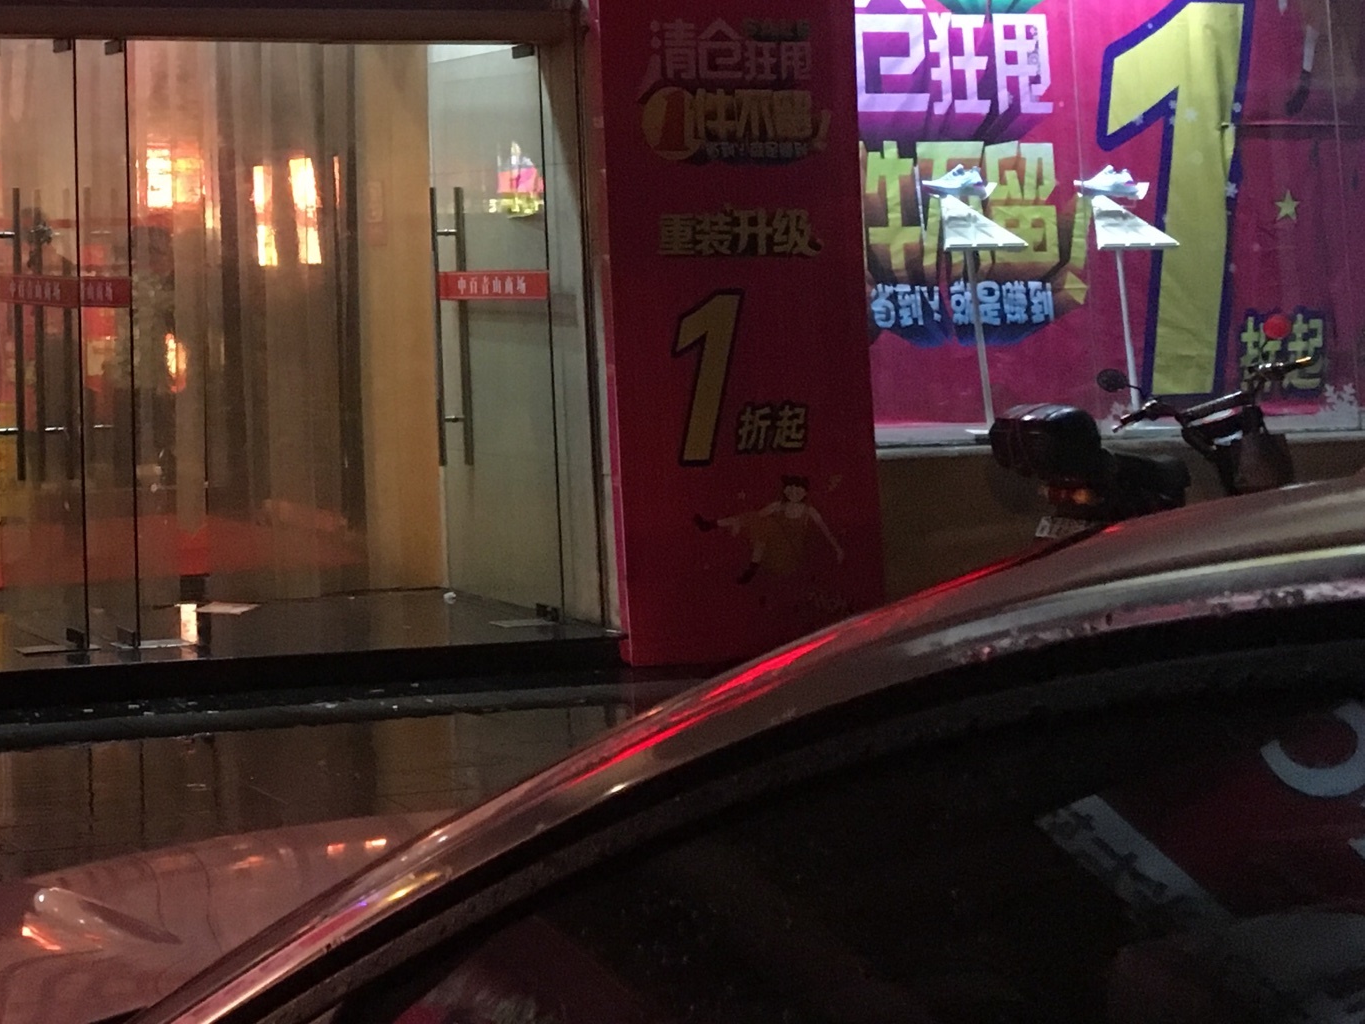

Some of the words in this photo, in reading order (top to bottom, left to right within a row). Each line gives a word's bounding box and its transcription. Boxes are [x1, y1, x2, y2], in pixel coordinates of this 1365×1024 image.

[657, 204, 825, 256] 重装升级
[671, 288, 744, 466] 1
[737, 403, 808, 450] 折起
